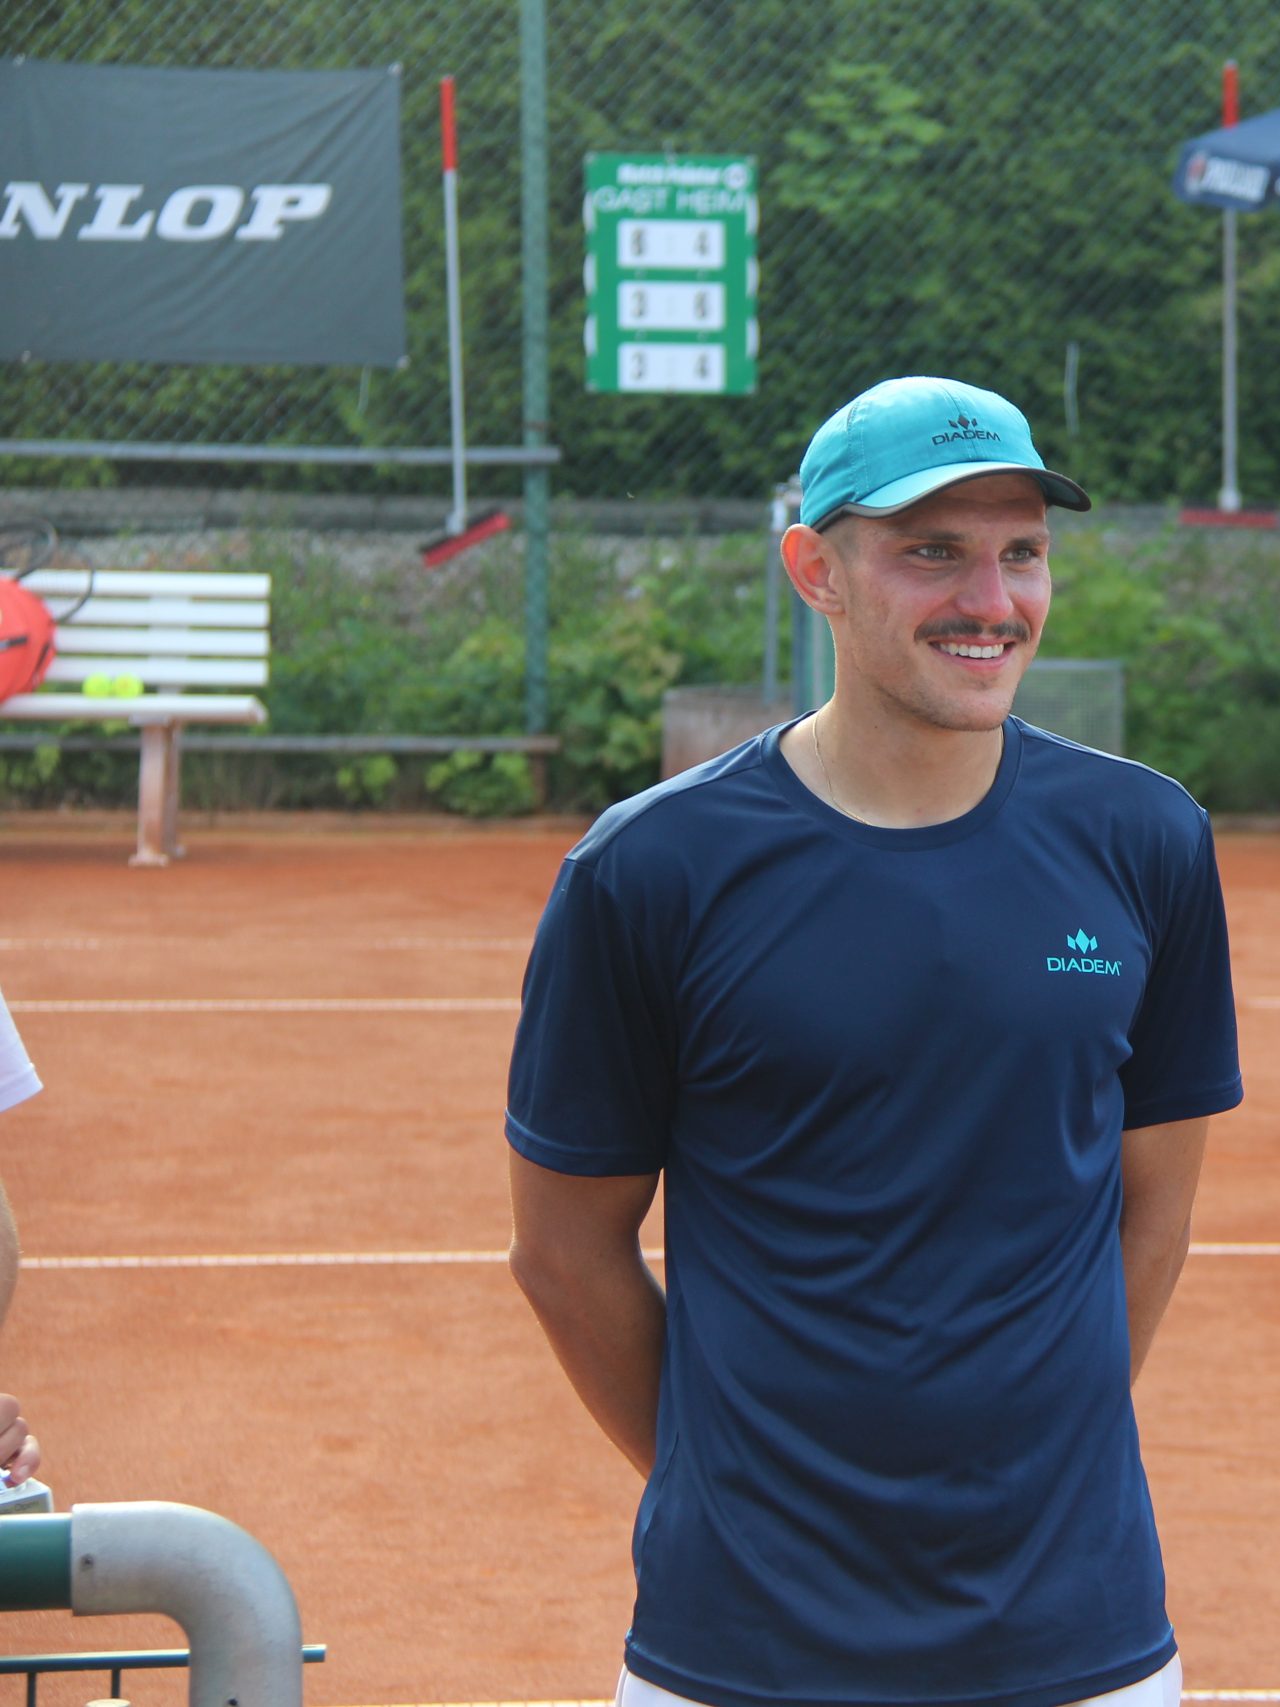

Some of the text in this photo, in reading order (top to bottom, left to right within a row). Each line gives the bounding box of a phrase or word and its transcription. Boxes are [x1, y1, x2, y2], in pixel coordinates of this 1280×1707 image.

[0, 180, 333, 242] NLOP
[592, 184, 668, 214] GAST
[931, 430, 1001, 446] DIADEM
[1046, 957, 1121, 977] DIADEM
